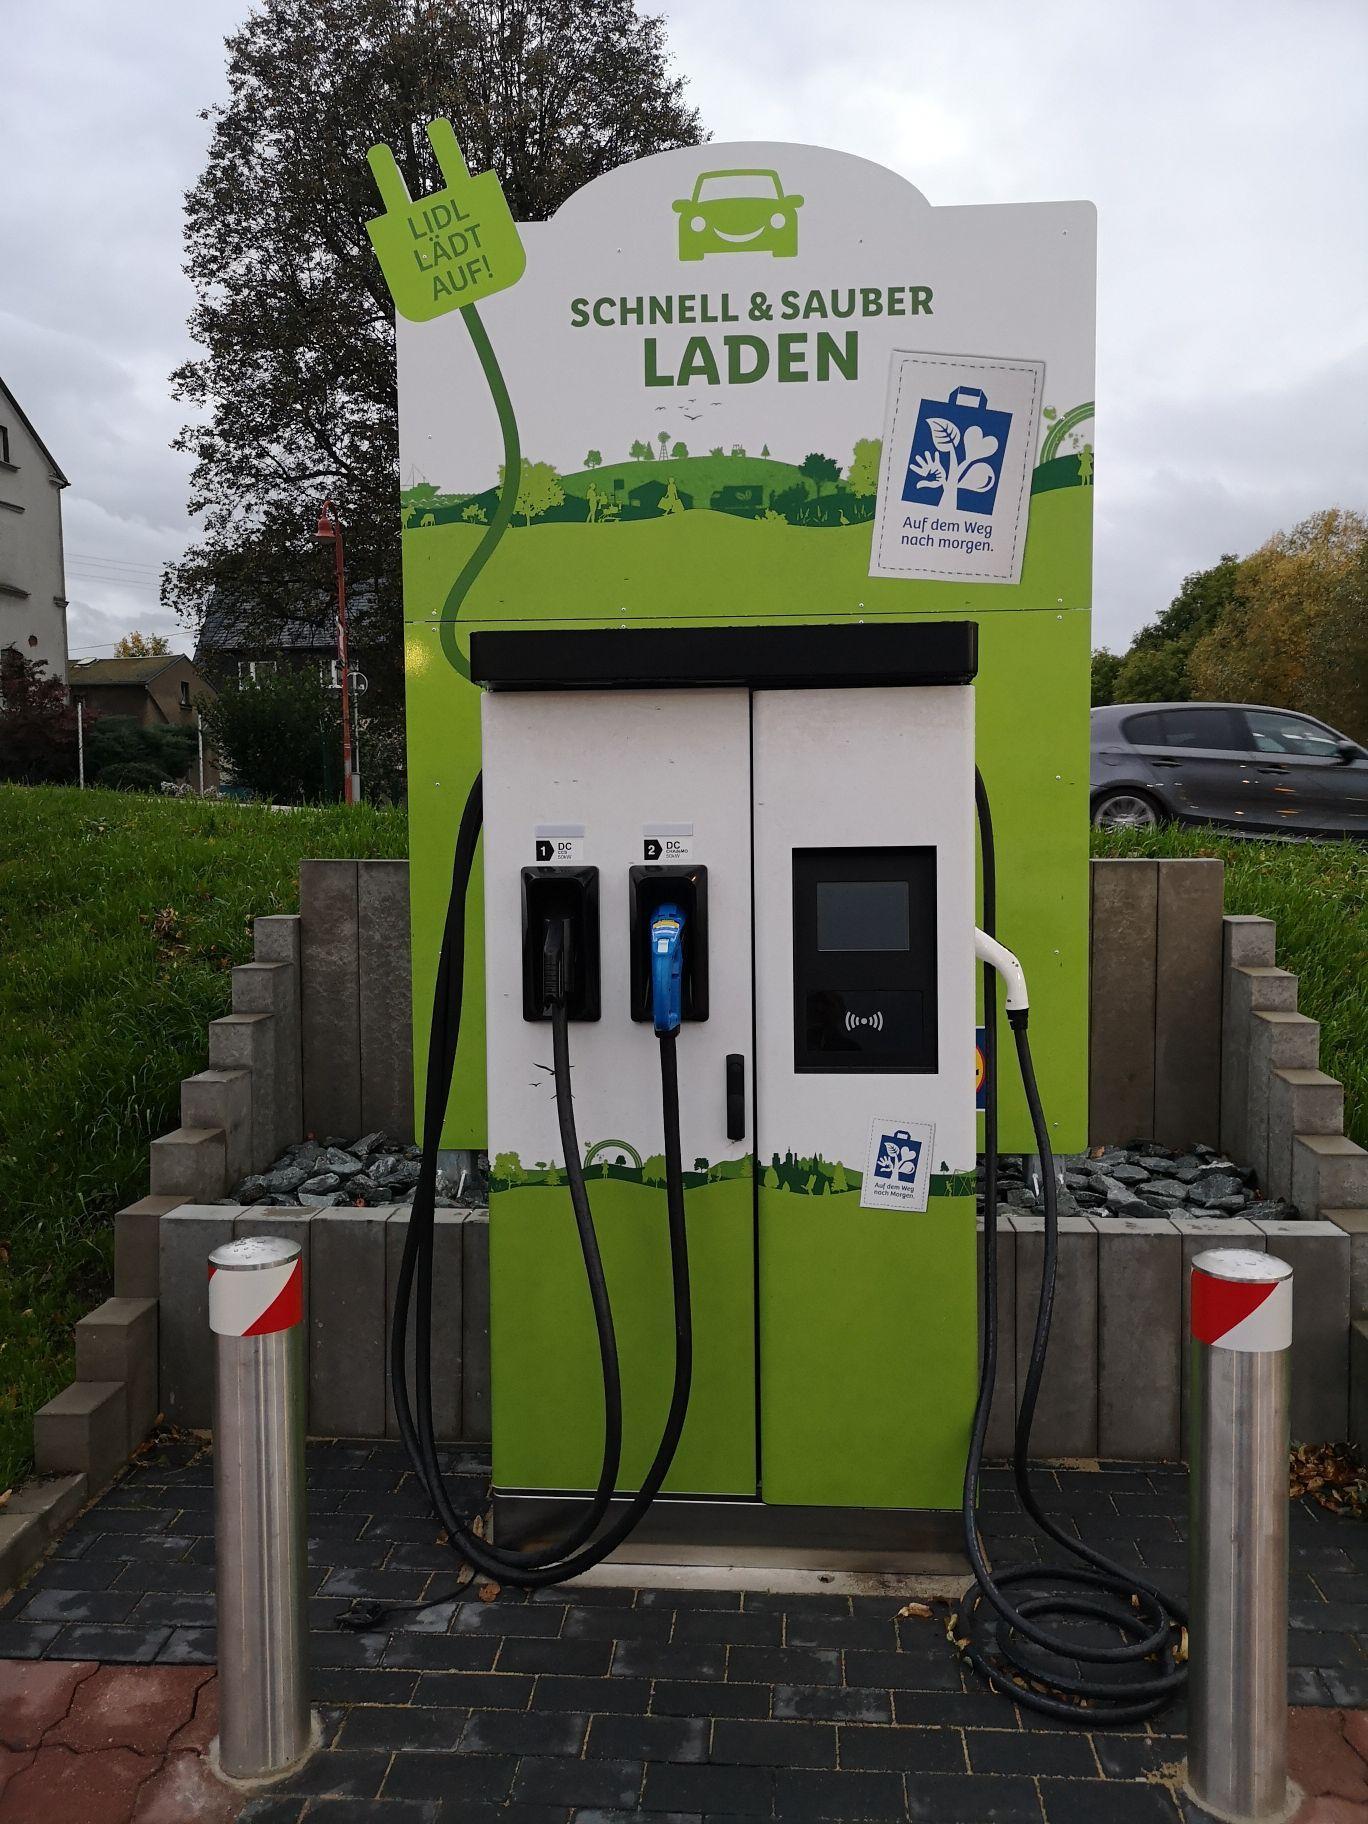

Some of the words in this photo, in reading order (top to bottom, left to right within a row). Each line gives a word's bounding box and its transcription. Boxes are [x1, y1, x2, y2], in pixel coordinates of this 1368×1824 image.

[407, 199, 470, 240] LIDL
[413, 223, 481, 272] LÄDT
[432, 254, 493, 301] AUF!
[570, 293, 739, 327] SCHNELL
[748, 291, 773, 321] &
[780, 286, 934, 320] SAUBER
[644, 331, 858, 387] LADEN
[902, 516, 928, 532] Auf
[930, 519, 960, 532] dem
[964, 521, 993, 539] Weg
[901, 534, 934, 547] nach
[938, 538, 994, 554] morgen.
[558, 842, 572, 850] DC
[648, 844, 656, 855] 2
[666, 841, 680, 849] DC
[874, 1182, 886, 1190] Auf
[901, 1185, 915, 1193] Weg
